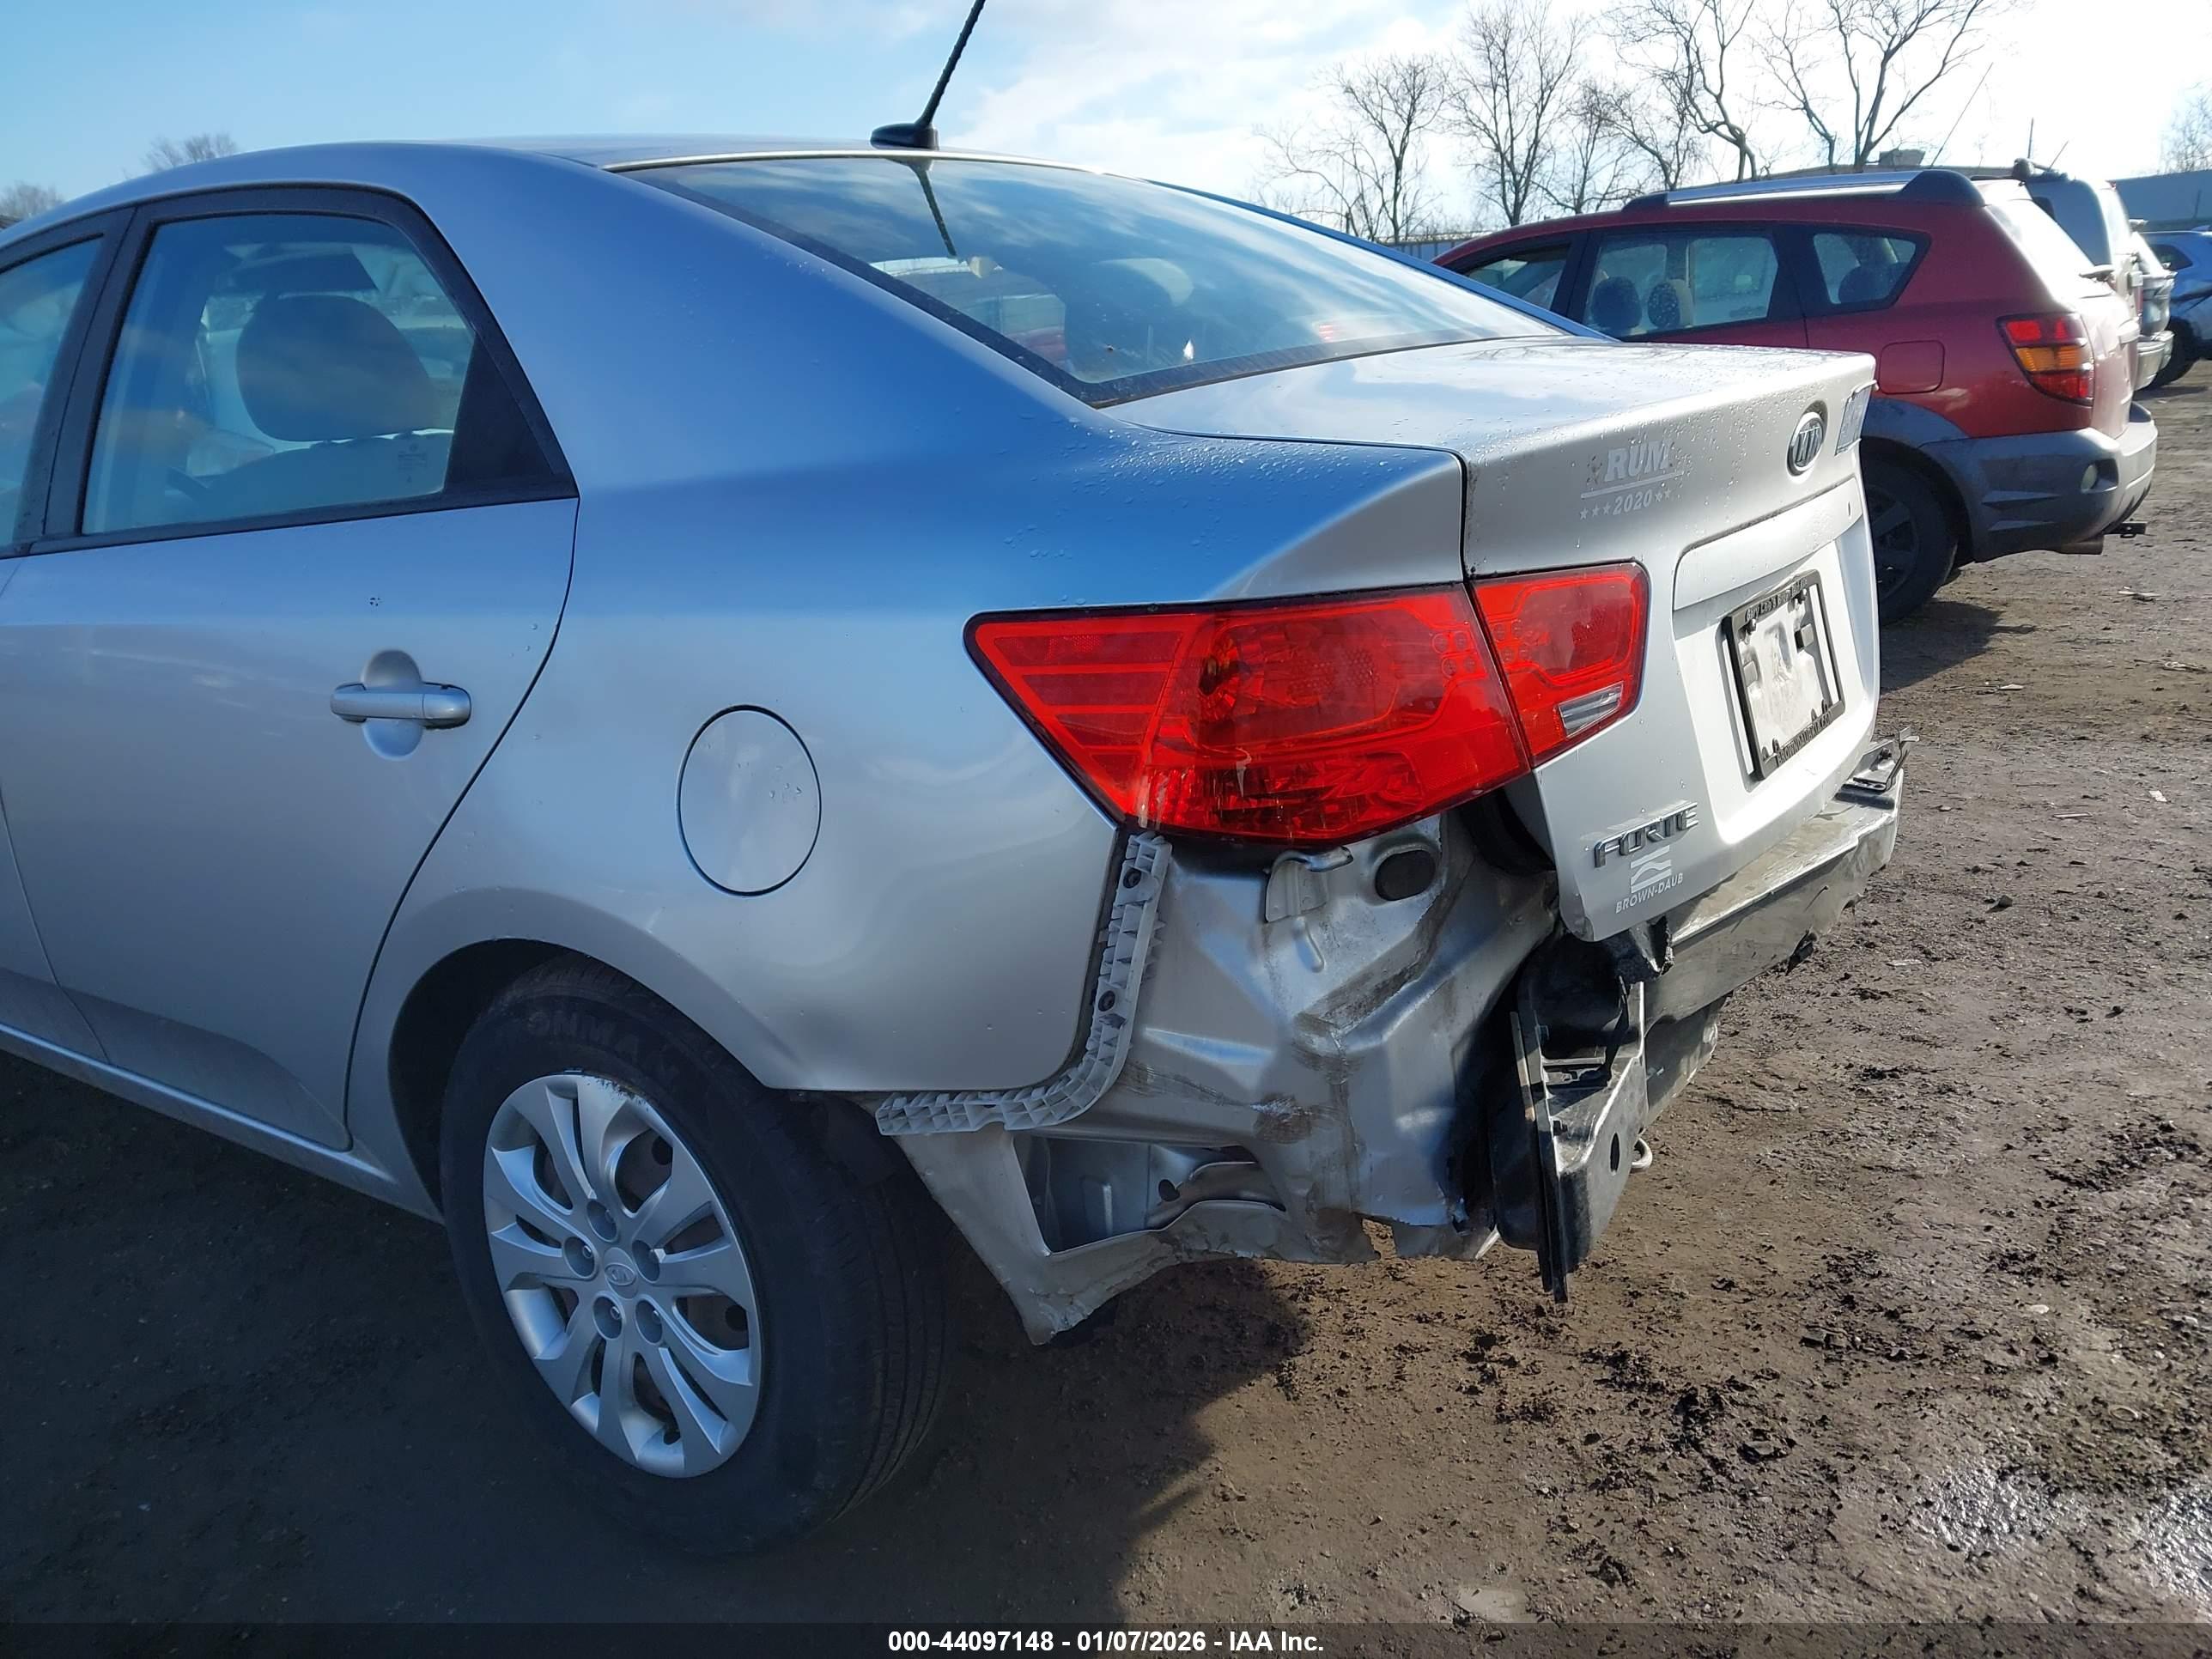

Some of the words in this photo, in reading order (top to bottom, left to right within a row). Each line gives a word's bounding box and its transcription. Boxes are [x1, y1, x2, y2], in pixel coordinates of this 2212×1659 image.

[1613, 489, 1653, 515] 2020
[1595, 802, 1699, 868] FORTE
[1615, 872, 1684, 915] BROWN-DAUB
